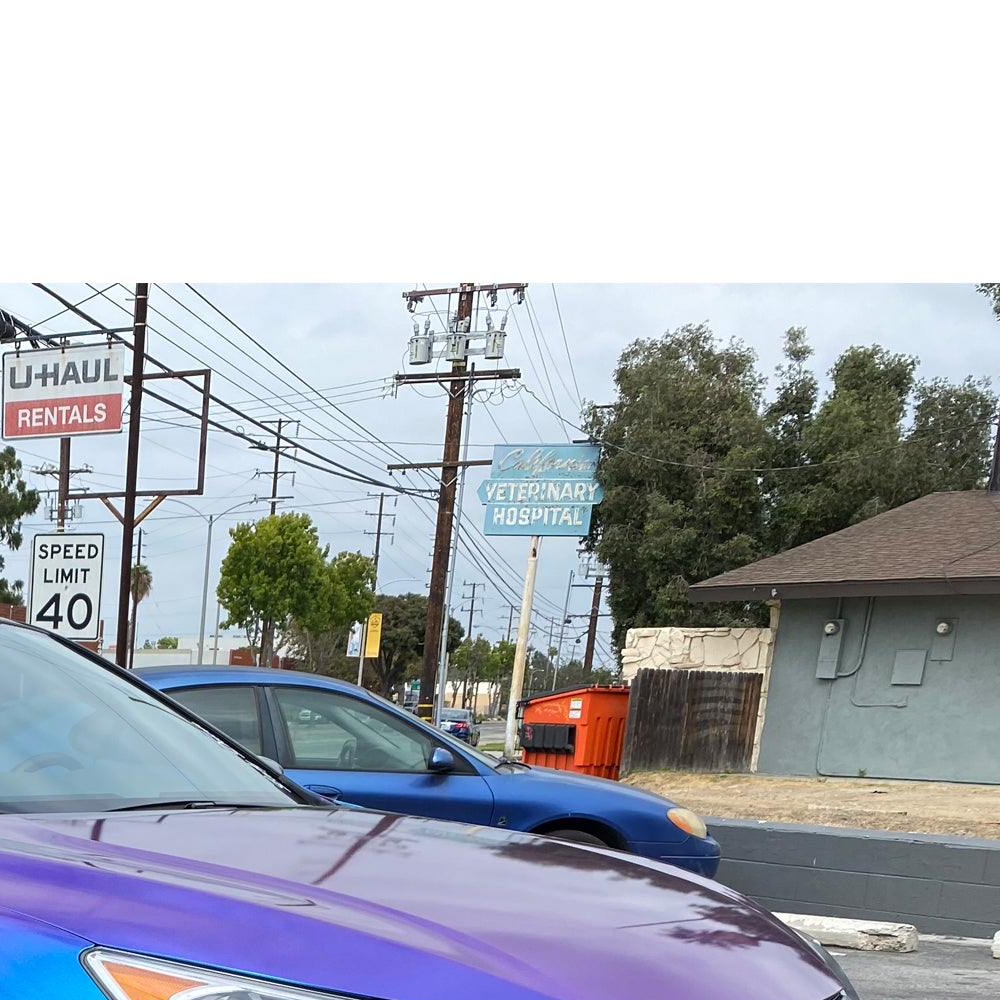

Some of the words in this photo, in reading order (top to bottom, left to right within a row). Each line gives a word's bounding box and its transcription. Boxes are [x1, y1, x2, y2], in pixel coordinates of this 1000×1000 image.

[10, 358, 119, 390] U-HAUL
[17, 403, 107, 428] RENTALS
[486, 483, 600, 501] VETERINARY
[493, 508, 583, 526] HOSPITAL
[38, 543, 99, 560] SPEED
[43, 568, 91, 584] LIMIT
[36, 593, 93, 630] 40
